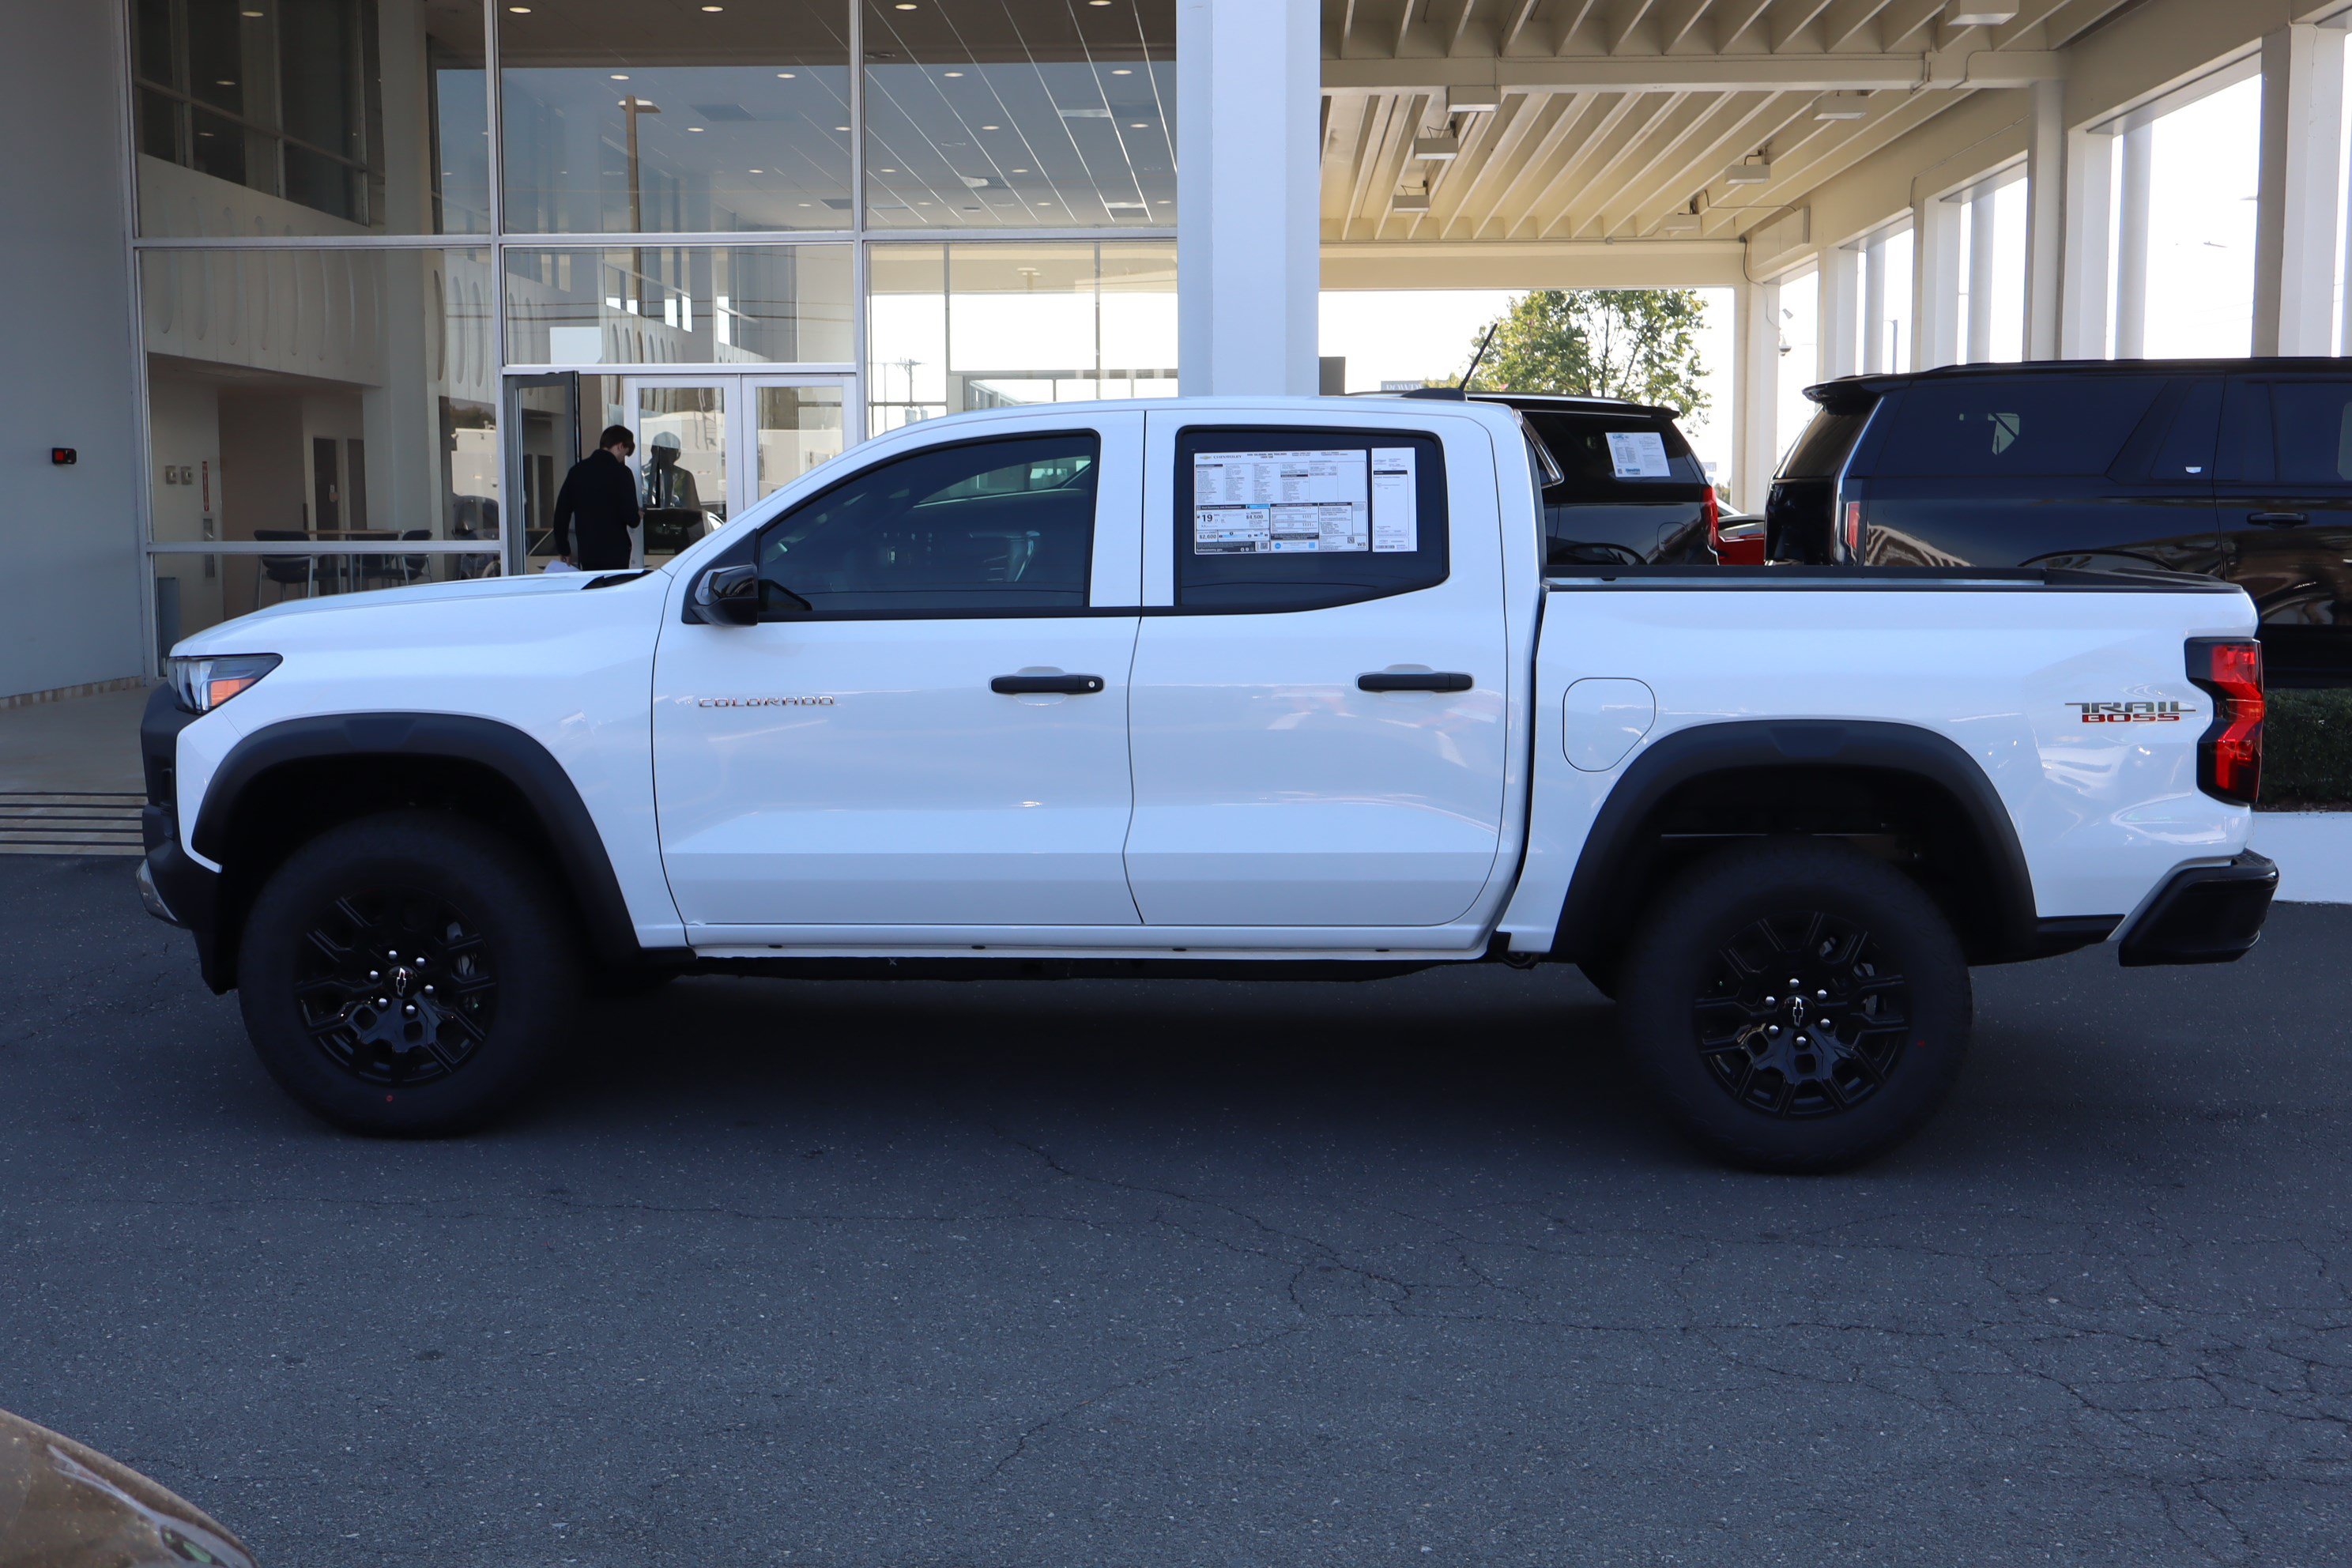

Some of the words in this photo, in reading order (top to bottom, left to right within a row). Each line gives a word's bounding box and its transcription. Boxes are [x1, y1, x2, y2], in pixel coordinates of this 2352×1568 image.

[698, 695, 835, 708] COLORADO
[2065, 701, 2196, 713] TRAIL
[2082, 713, 2180, 723] BOSS
